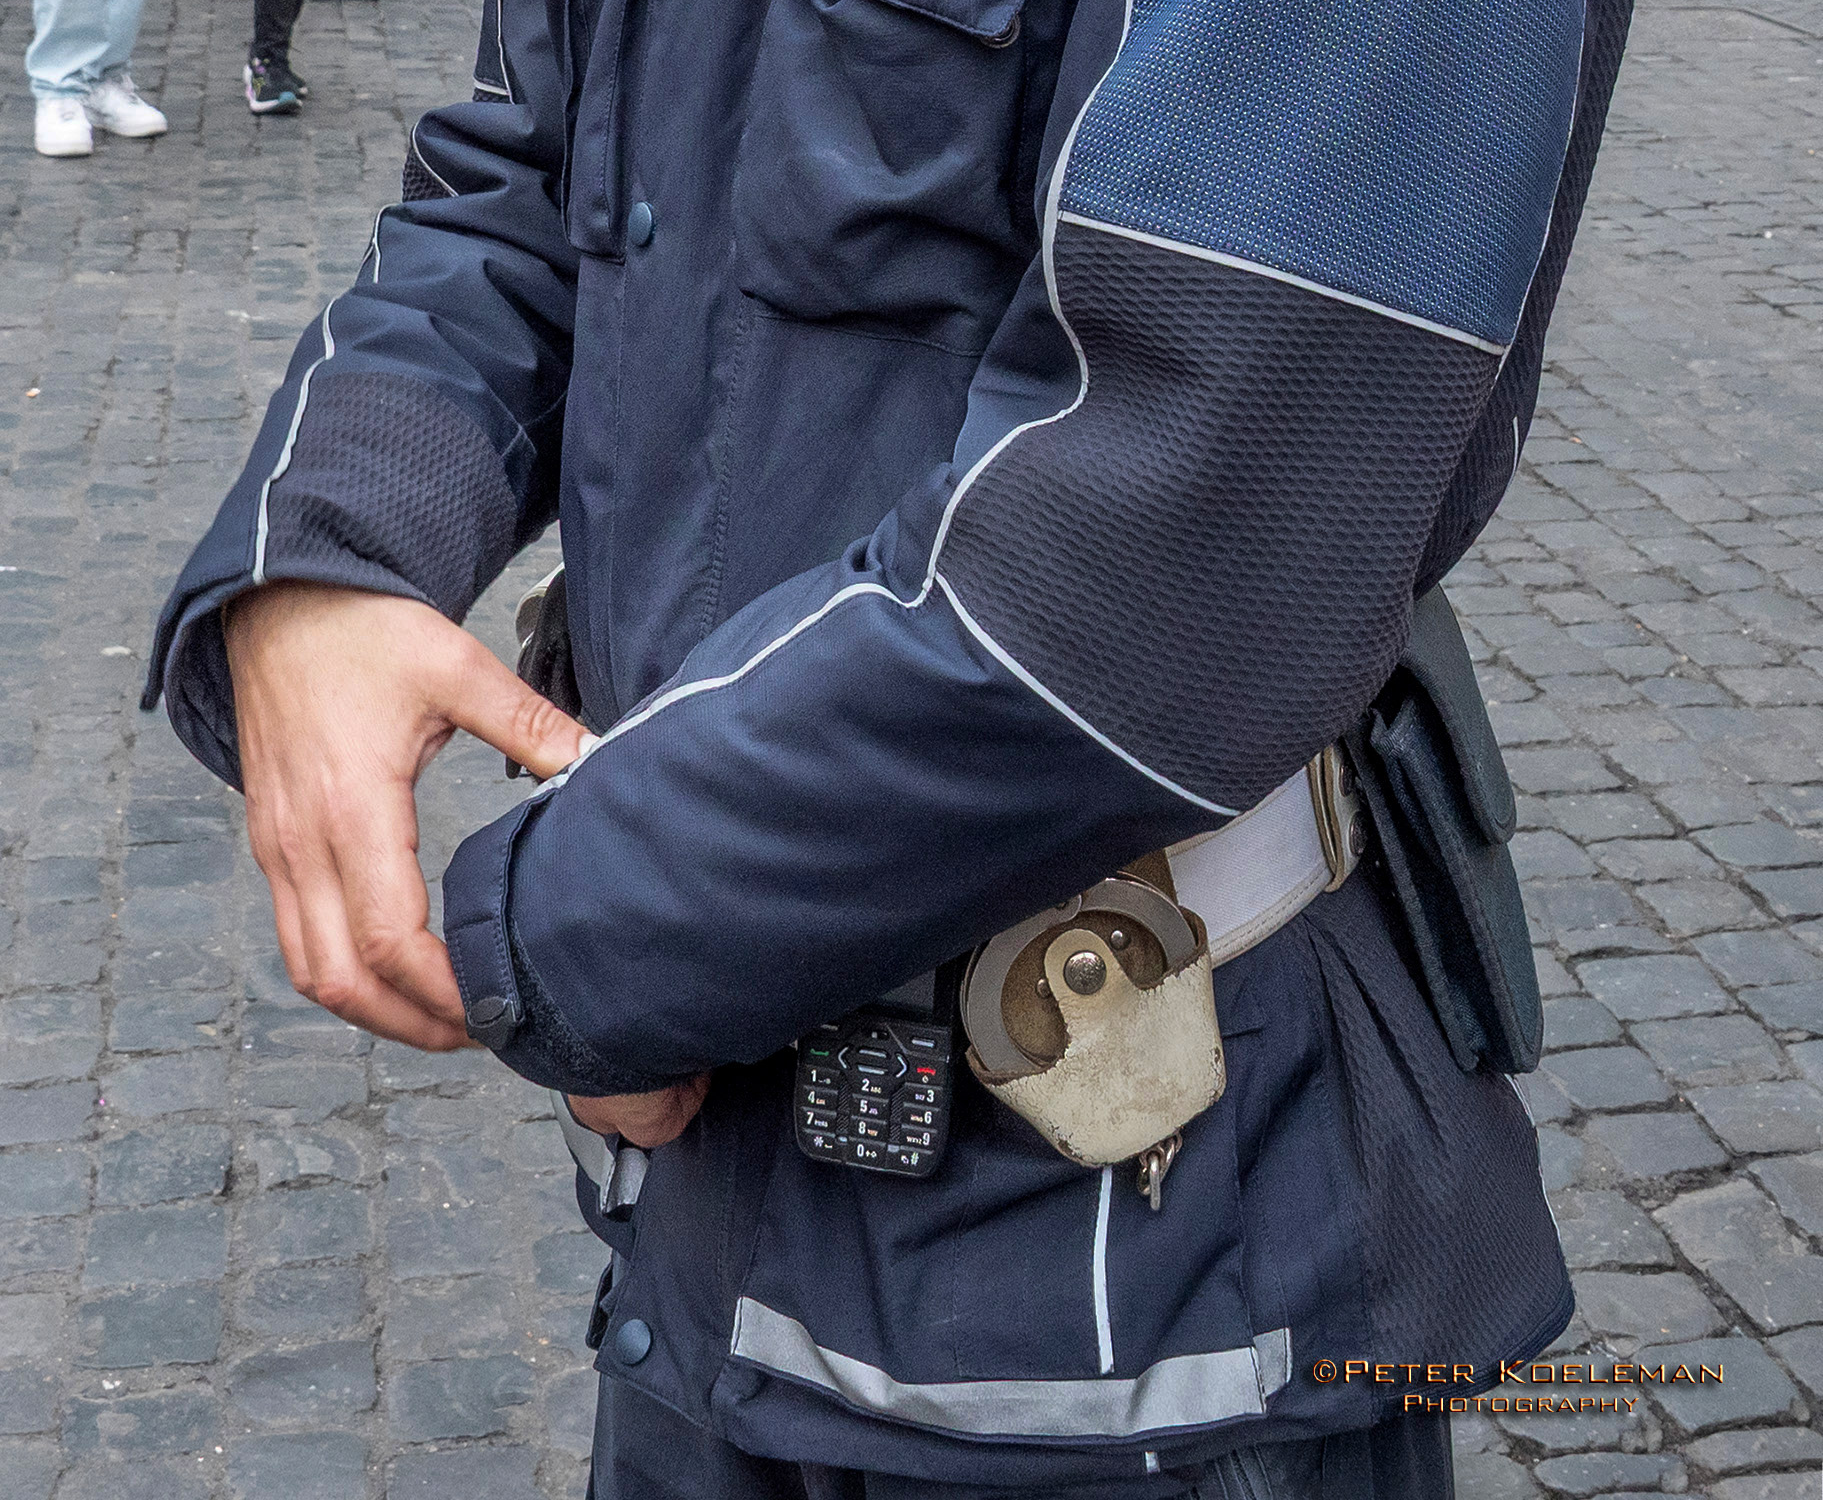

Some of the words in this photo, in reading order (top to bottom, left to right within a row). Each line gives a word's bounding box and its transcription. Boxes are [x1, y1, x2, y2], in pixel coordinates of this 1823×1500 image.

[811, 1069, 817, 1082] 1
[861, 1078, 870, 1092] 2
[807, 1091, 815, 1104] 4
[926, 1089, 935, 1103] 3
[860, 1099, 868, 1113] 5
[806, 1111, 814, 1125] 7
[924, 1111, 933, 1125] 6
[858, 1121, 866, 1135] 8
[922, 1132, 931, 1146] 9
[856, 1143, 865, 1157] 0
